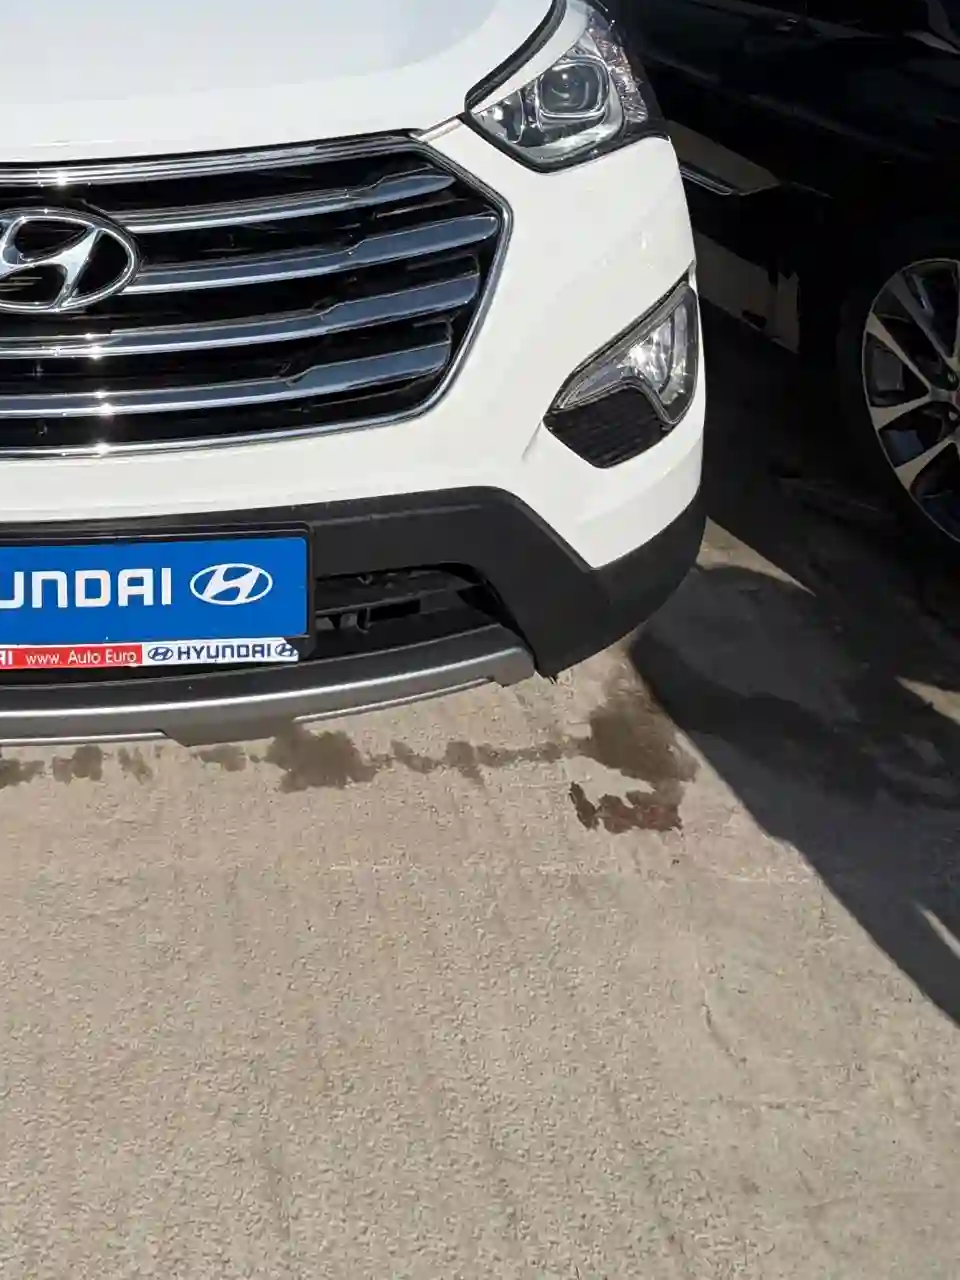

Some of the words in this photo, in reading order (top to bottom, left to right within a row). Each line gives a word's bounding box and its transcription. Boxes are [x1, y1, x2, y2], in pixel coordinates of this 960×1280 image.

[25, 653, 62, 665] www.
[67, 649, 101, 665] Auto
[105, 648, 137, 664] Euro
[178, 643, 271, 661] HYUNDAI
